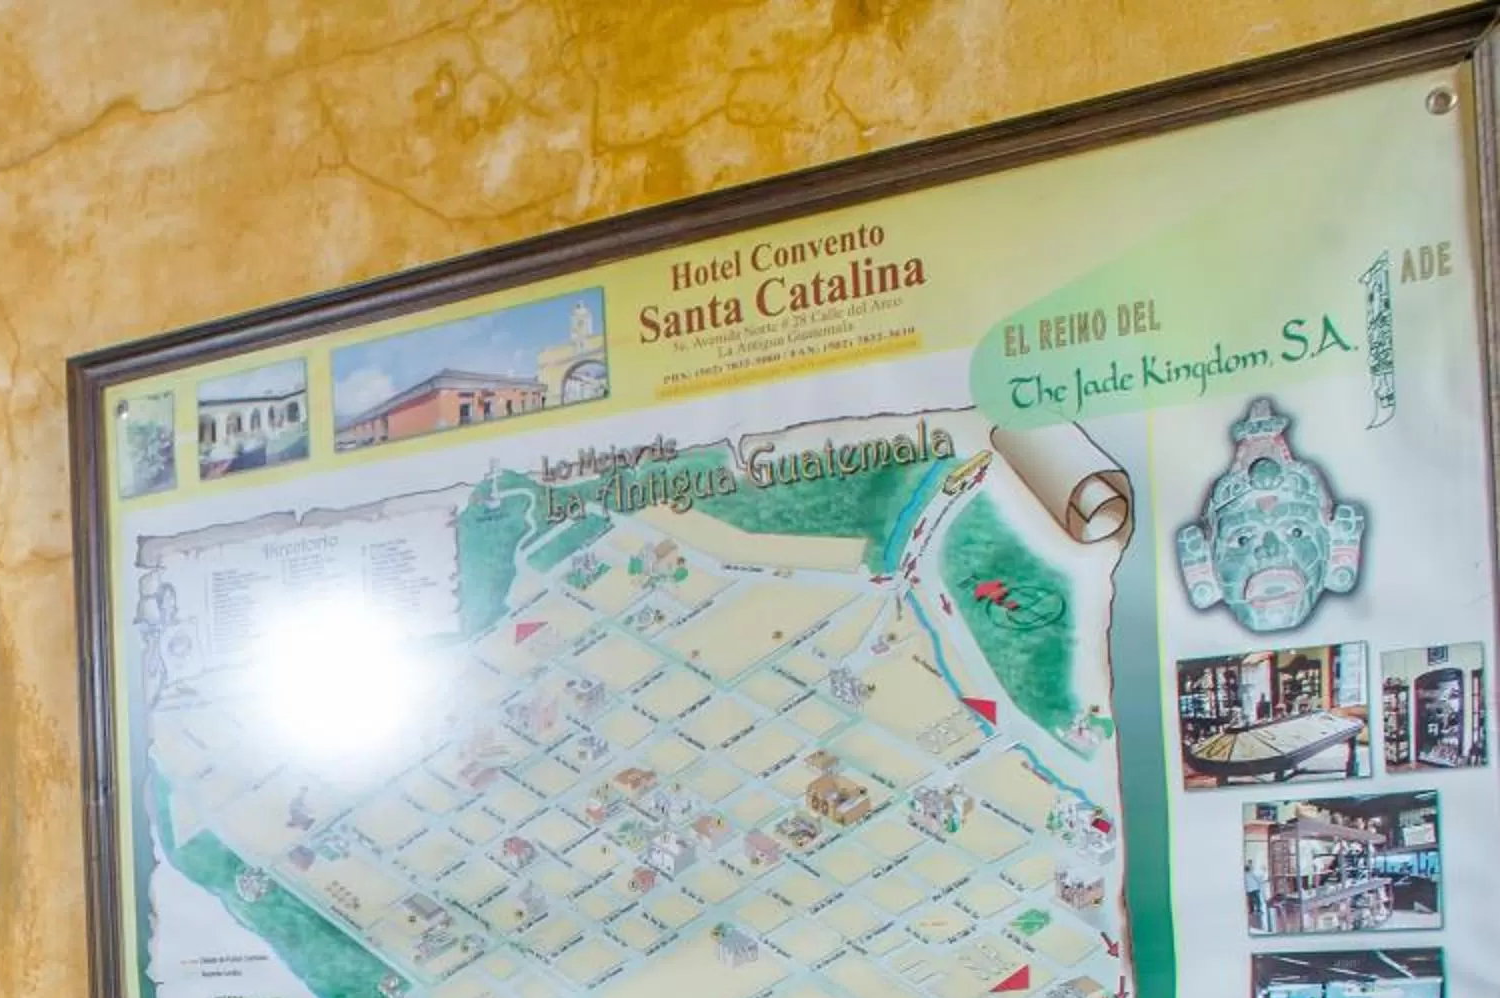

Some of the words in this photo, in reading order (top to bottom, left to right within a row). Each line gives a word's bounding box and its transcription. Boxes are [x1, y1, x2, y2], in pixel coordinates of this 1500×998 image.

[671, 250, 742, 292] Hotel
[751, 223, 886, 272] Convento
[639, 295, 745, 345] Santa
[755, 256, 928, 318] Catalina
[1003, 326, 1030, 358] EL
[1039, 310, 1108, 351] REINO
[1117, 299, 1162, 338] DEL
[1009, 375, 1067, 410] The
[1075, 361, 1135, 413] Jade
[541, 454, 574, 483] Lo
[577, 443, 645, 476] Mejor
[650, 433, 678, 461] de
[546, 485, 587, 525] La
[596, 465, 738, 522] Antigua
[744, 416, 956, 490] Guatemala
